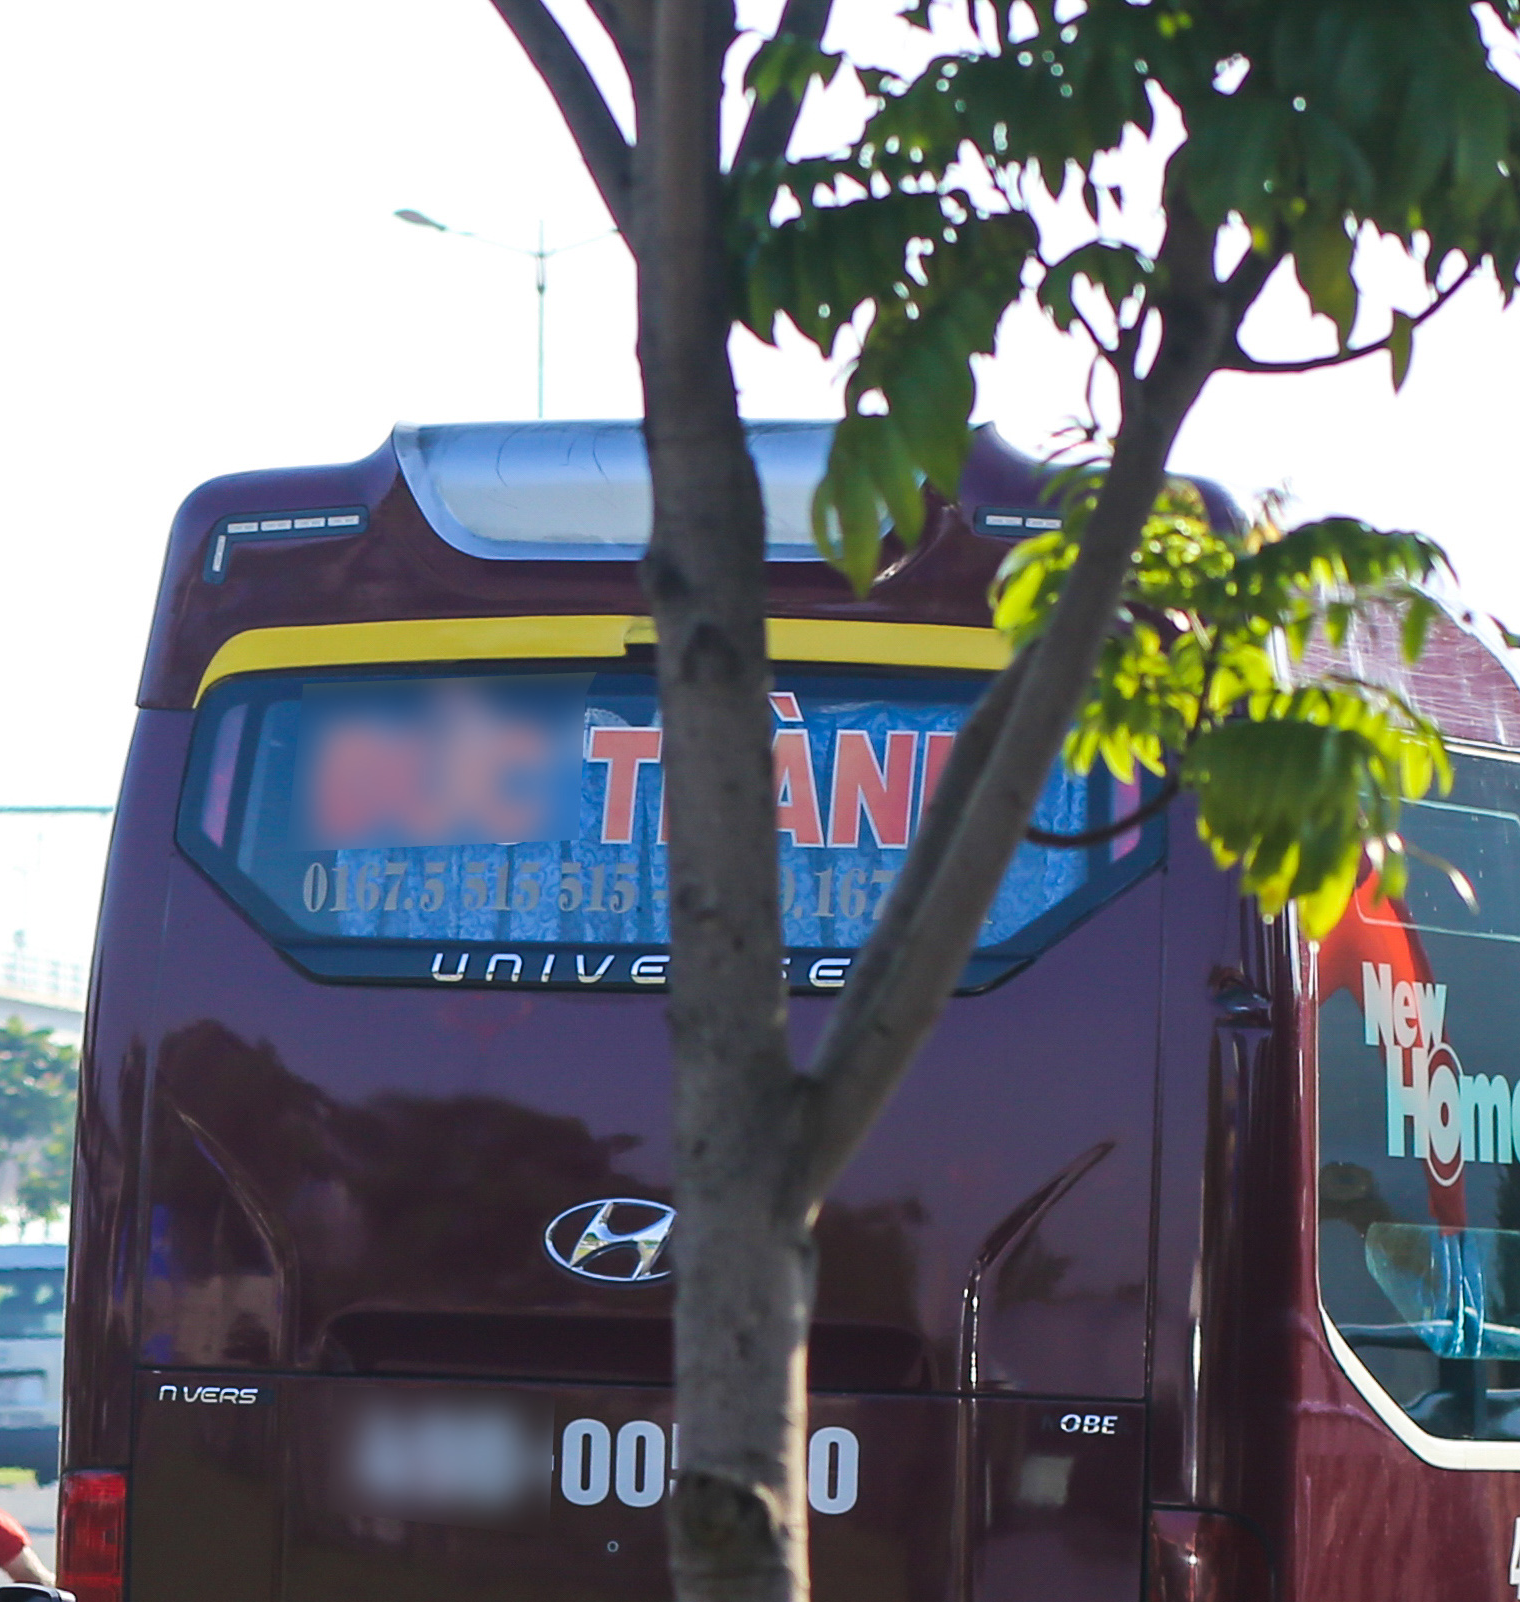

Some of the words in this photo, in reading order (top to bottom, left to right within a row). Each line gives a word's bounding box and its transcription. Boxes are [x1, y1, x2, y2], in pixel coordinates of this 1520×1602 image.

[465, 862, 542, 912] 515
[559, 862, 636, 914] 515
[432, 952, 851, 989] UNIVEE
[1362, 961, 1447, 1048] New
[1385, 1046, 1520, 1165] Hom
